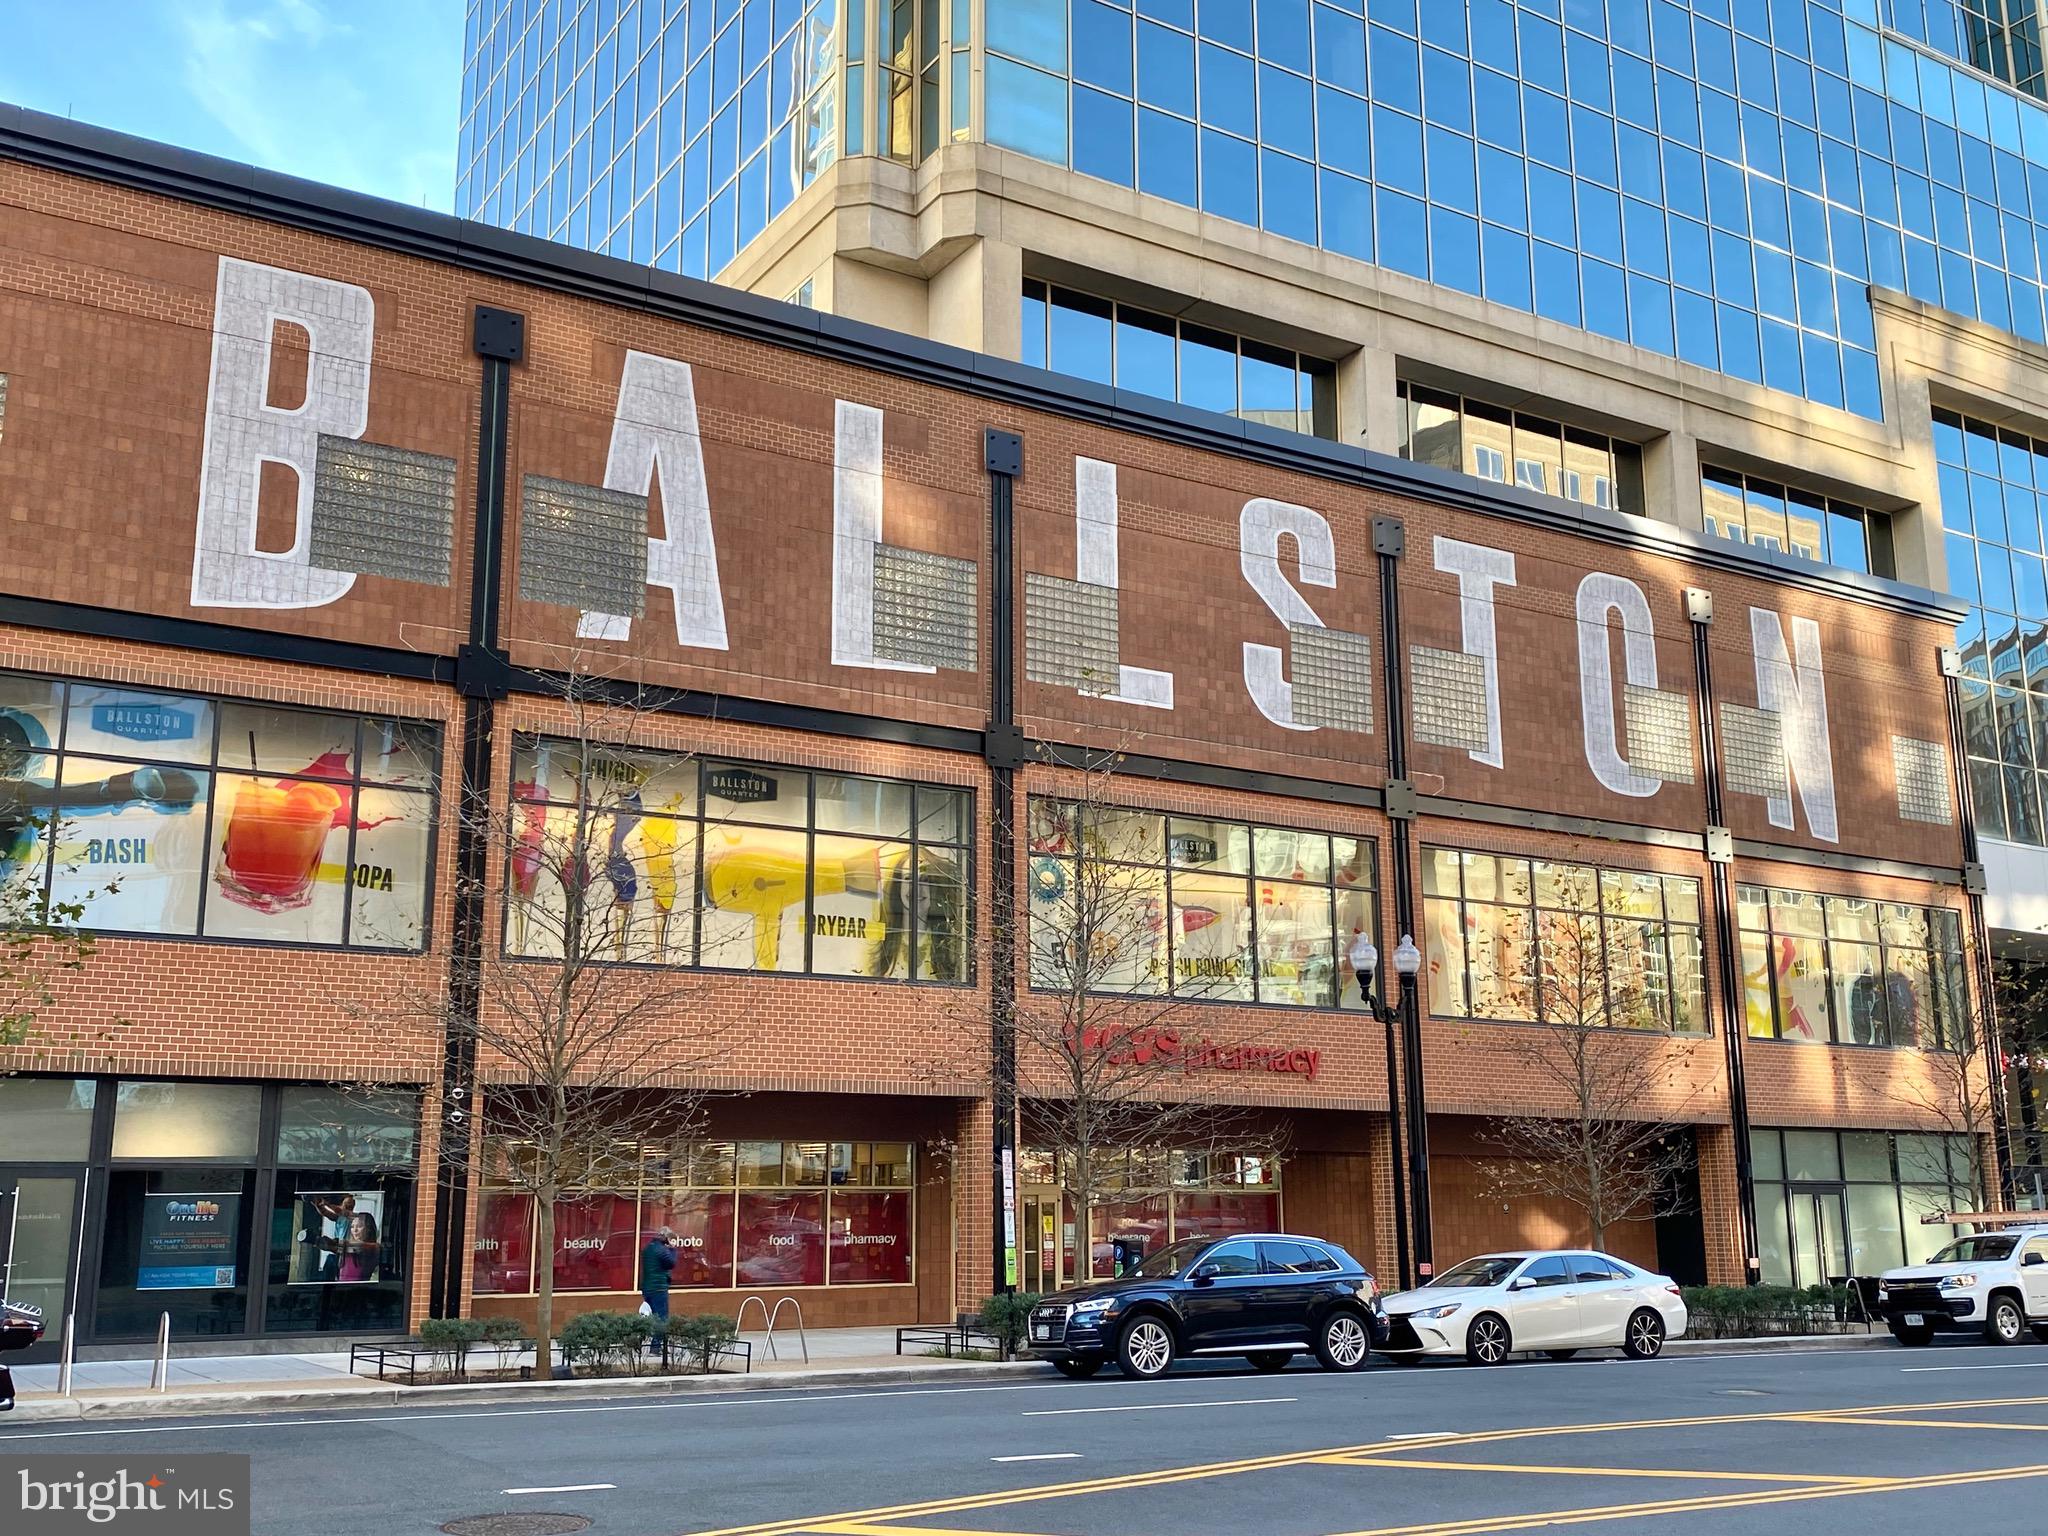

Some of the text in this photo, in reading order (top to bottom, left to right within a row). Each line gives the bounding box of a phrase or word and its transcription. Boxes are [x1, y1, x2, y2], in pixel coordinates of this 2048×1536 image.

[190, 255, 1839, 845] BALLSTON
[107, 710, 181, 729] BALLSTON
[117, 725, 168, 736] QUARTER
[712, 775, 767, 793] BALLSTON
[721, 789, 759, 799] QUARTER
[89, 838, 146, 864] BASH
[1185, 1037, 1321, 1082] pharmacy
[475, 1238, 499, 1250] alth
[563, 1237, 607, 1251] beauty
[769, 1234, 795, 1246] food
[844, 1233, 897, 1246] pharmacy
